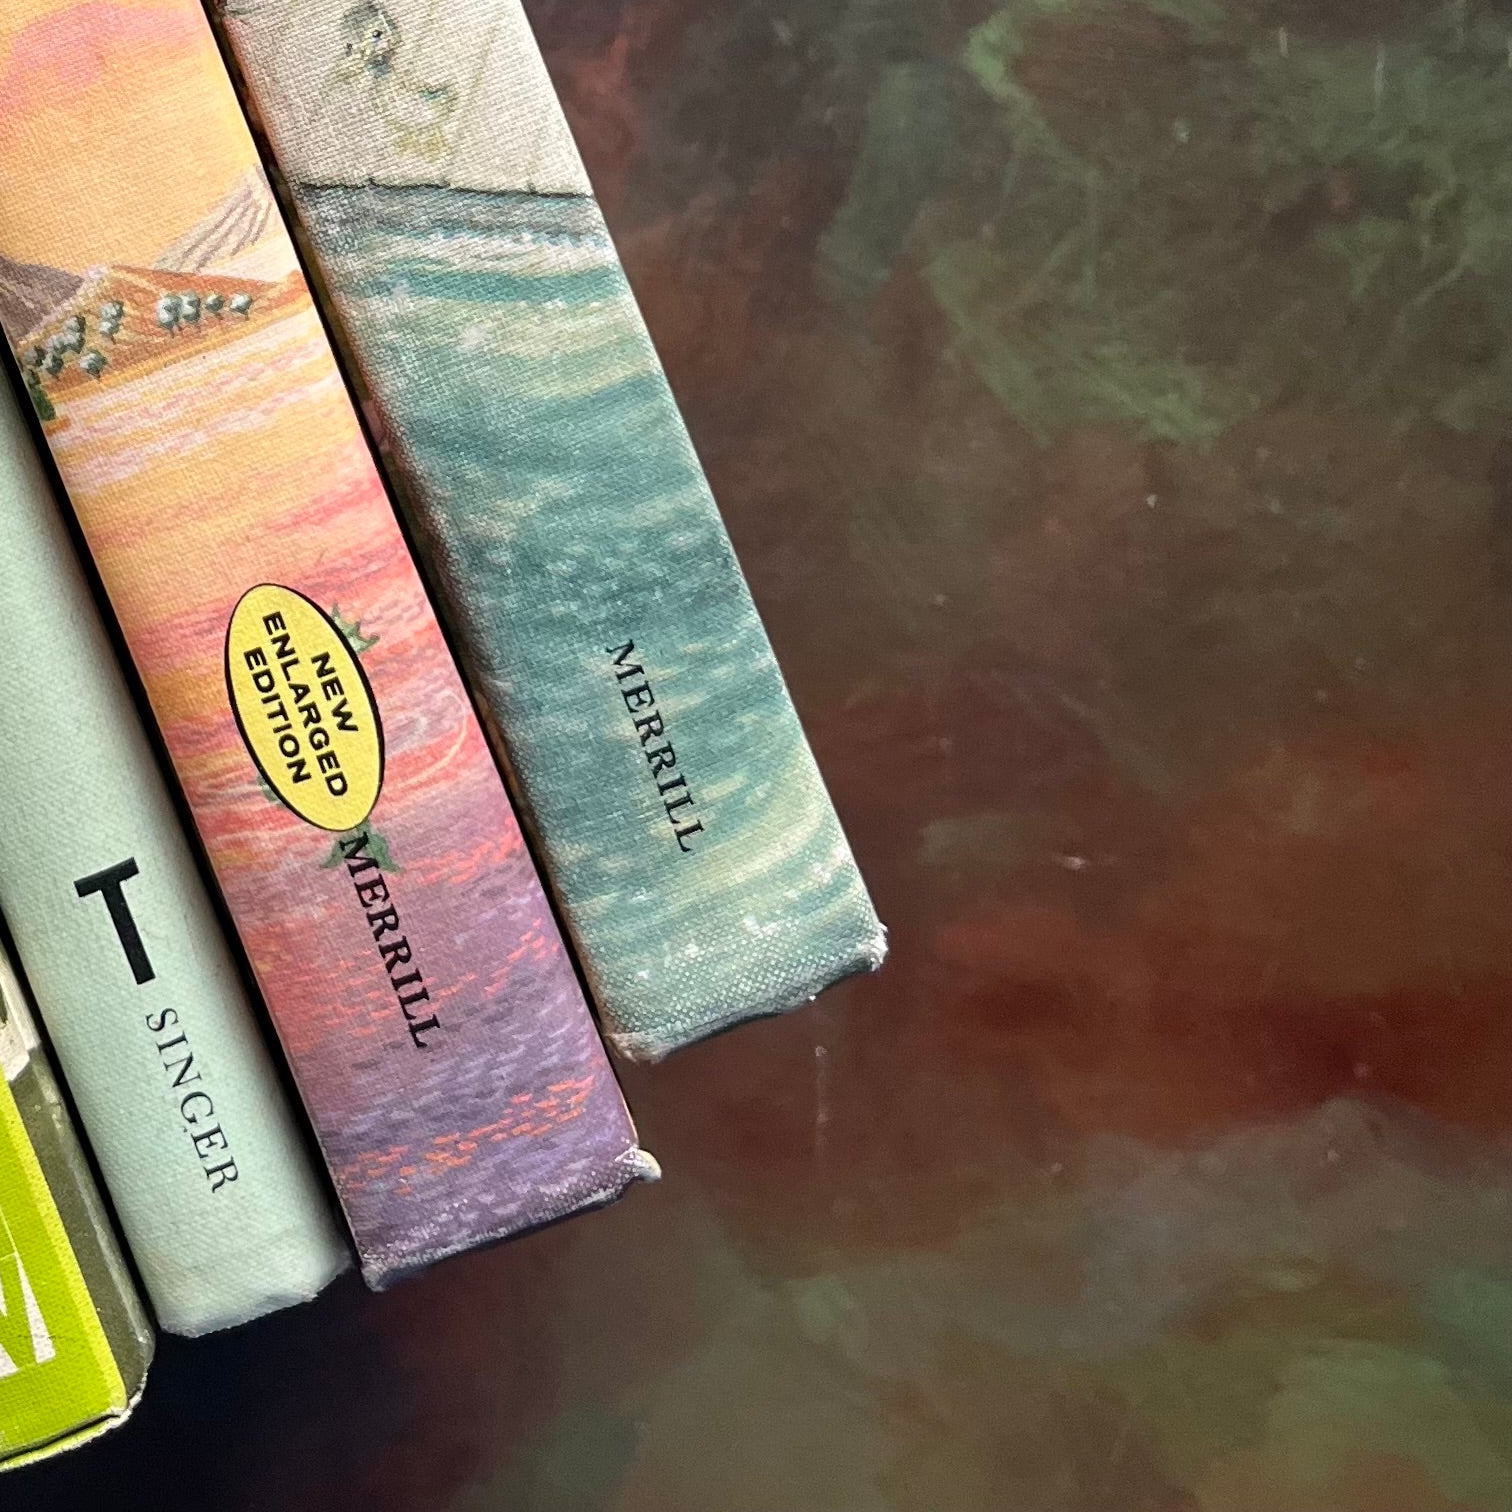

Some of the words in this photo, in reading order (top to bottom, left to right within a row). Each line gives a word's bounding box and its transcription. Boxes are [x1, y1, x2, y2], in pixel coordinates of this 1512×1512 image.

[243, 646, 312, 785] EDITION
[262, 610, 349, 798] ENLARGED
[311, 651, 359, 734] NEW
[605, 639, 705, 853] MERRILL
[73, 856, 156, 985] T
[339, 831, 441, 1049] MERRILL
[145, 1007, 240, 1193] SINGER
